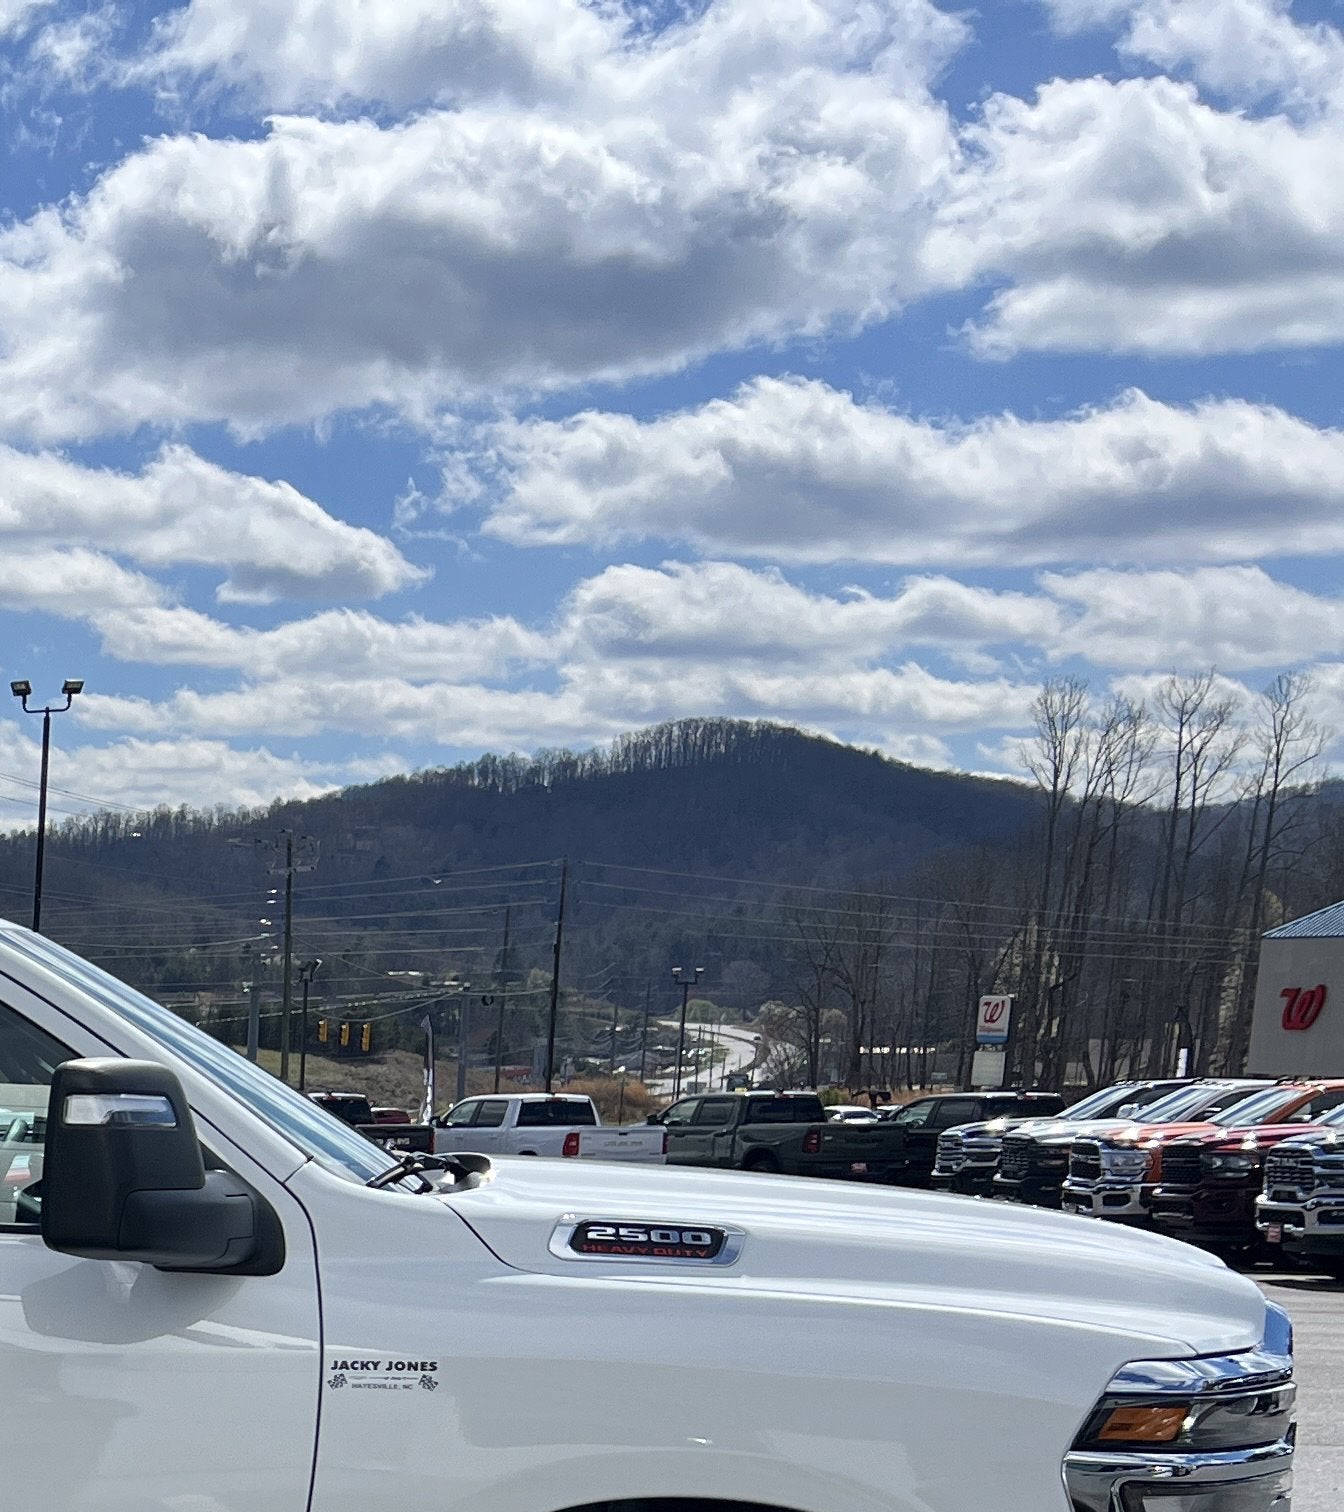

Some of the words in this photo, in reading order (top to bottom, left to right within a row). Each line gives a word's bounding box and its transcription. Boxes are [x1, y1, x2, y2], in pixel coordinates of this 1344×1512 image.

[982, 1000, 1006, 1024] W
[1280, 983, 1327, 1031] W
[586, 1226, 712, 1246] 2500
[581, 1243, 650, 1255] HEAVY
[653, 1247, 709, 1258] DUTY
[330, 1360, 381, 1371] JACKY
[385, 1361, 438, 1372] JONES
